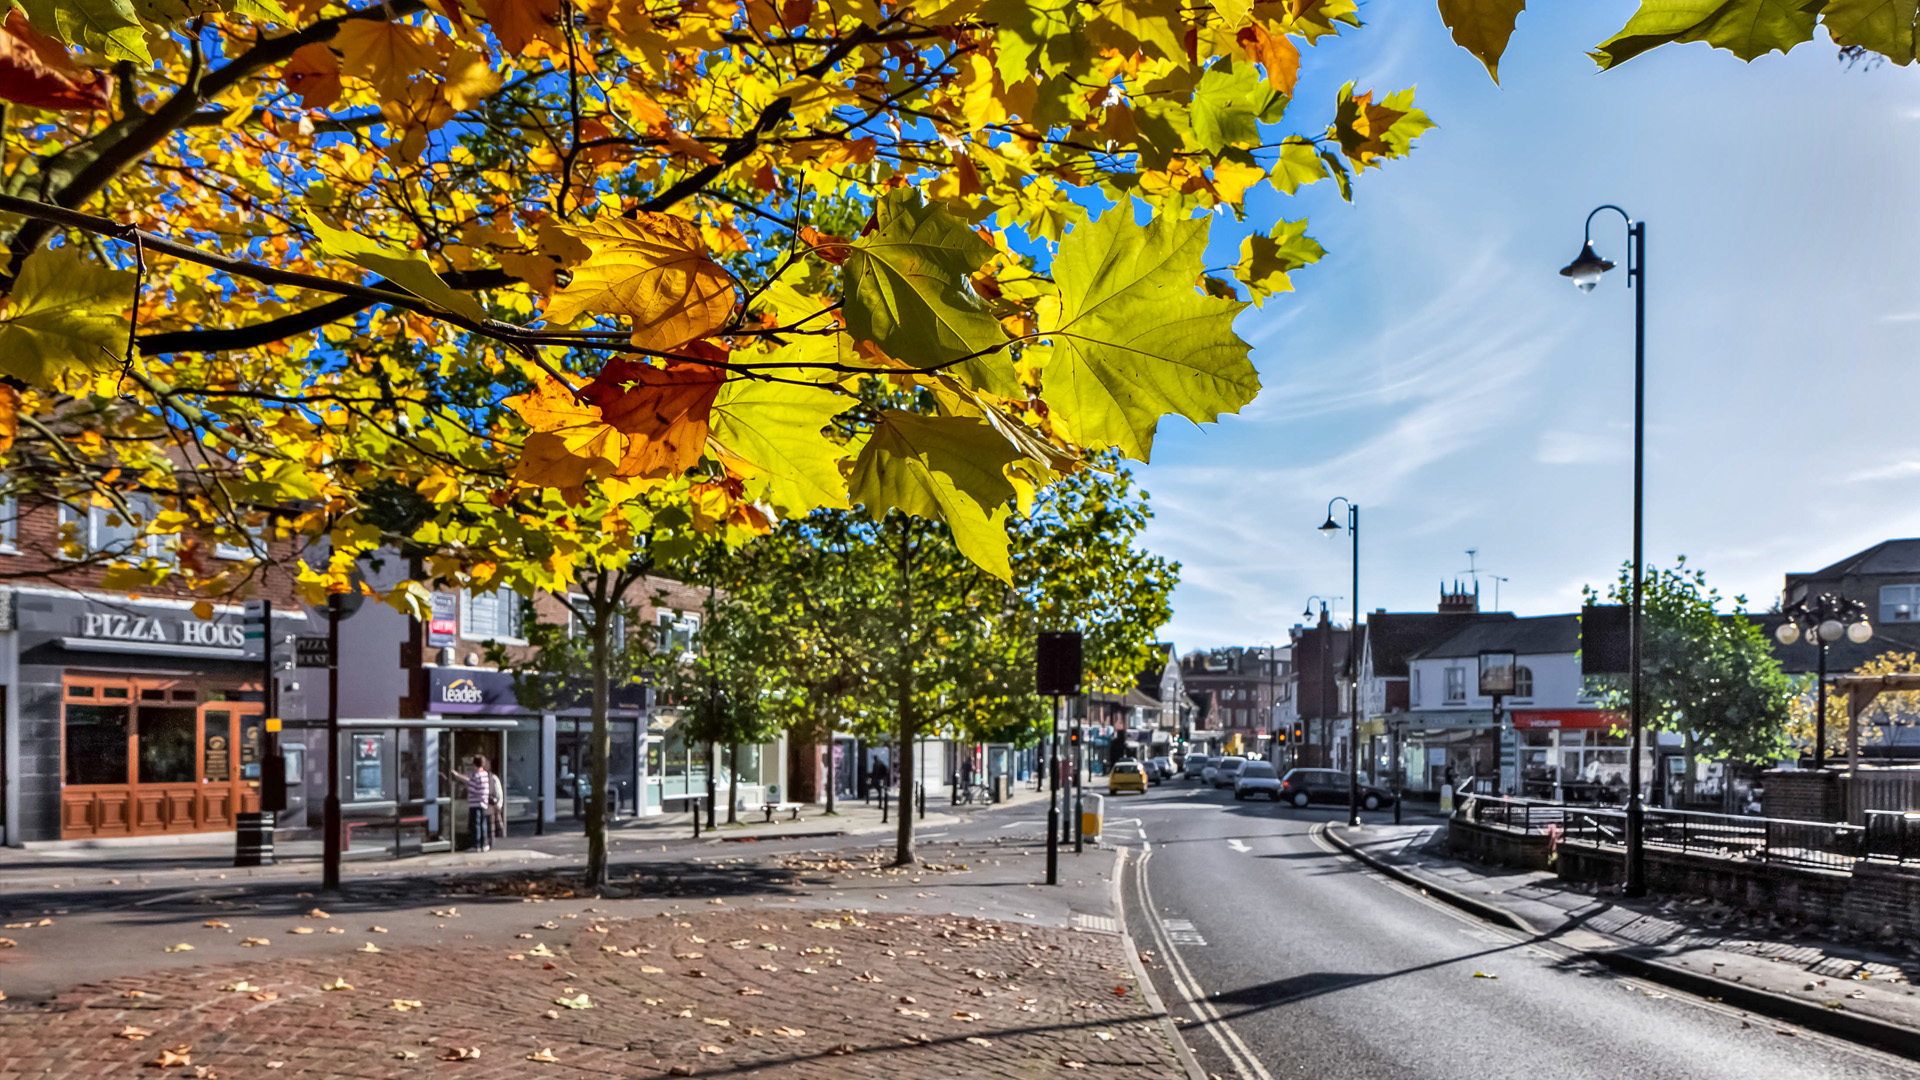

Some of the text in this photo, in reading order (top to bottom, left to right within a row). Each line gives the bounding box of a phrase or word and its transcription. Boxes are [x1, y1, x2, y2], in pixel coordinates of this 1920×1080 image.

[85, 612, 245, 647] PIZZA HOUS
[442, 685, 483, 703] Leaders
